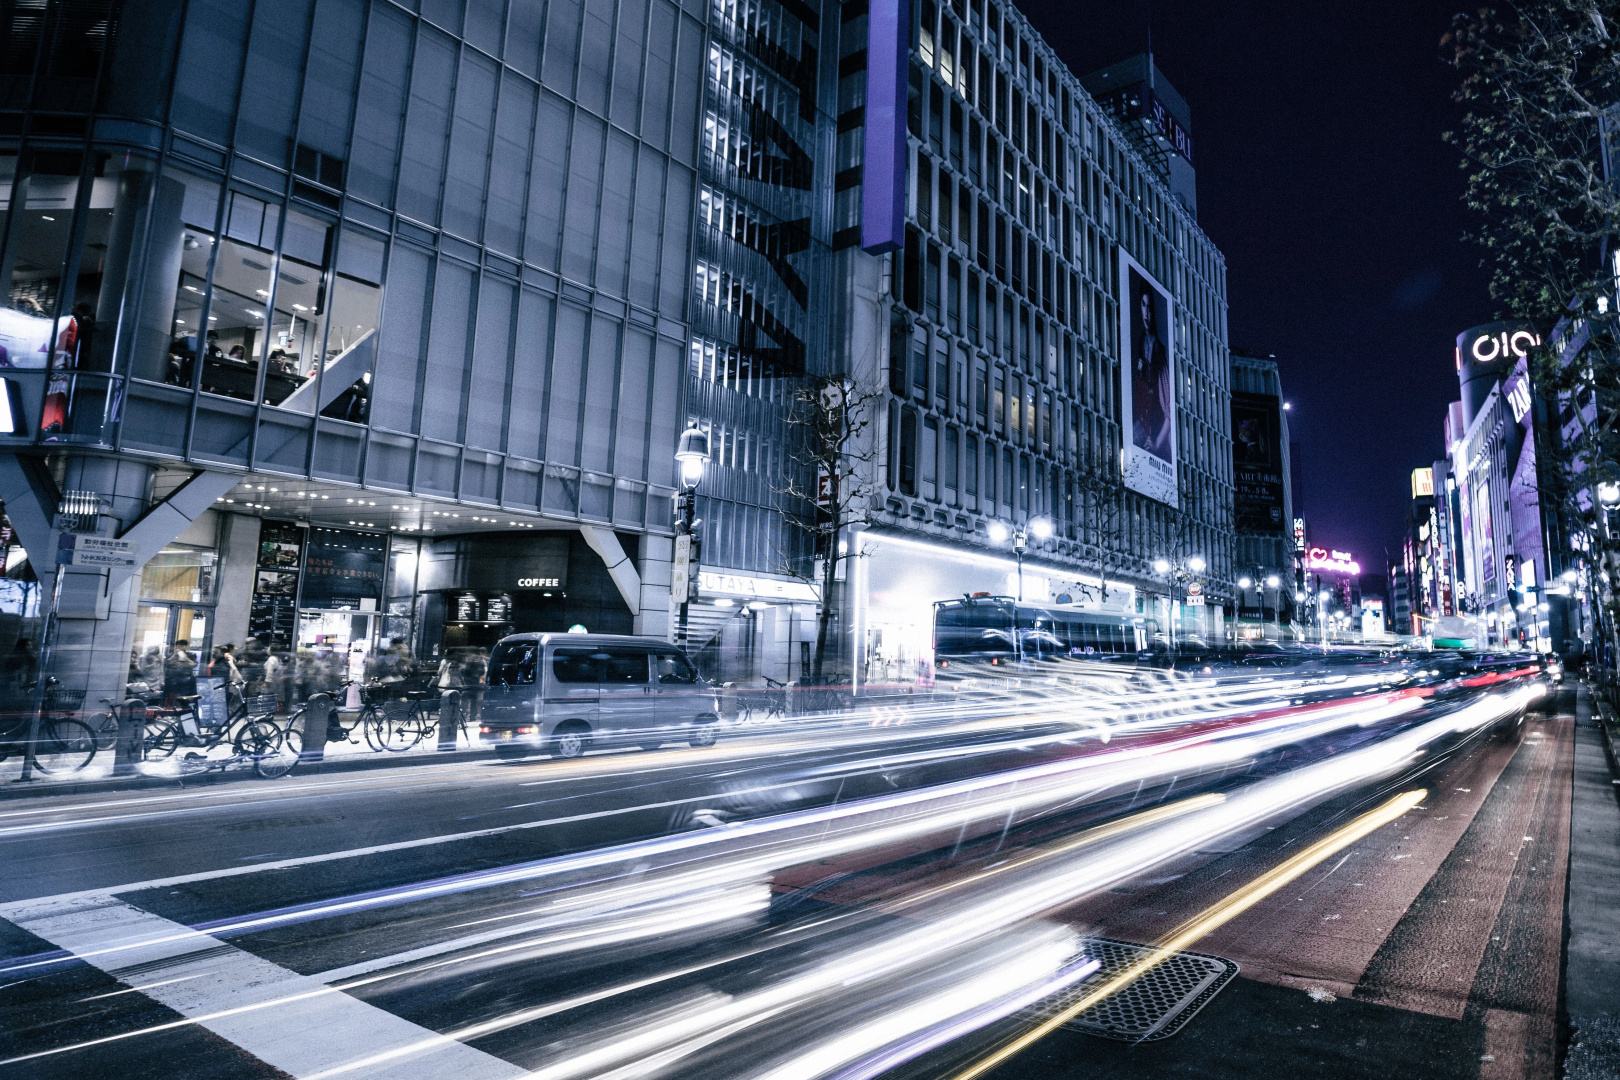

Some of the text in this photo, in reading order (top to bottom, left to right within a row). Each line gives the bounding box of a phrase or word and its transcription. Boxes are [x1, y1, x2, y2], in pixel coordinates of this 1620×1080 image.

[1153, 99, 1191, 161] SEIBU
[518, 578, 559, 587] COFFEE
[675, 540, 685, 597] 公園通り
[1506, 559, 1516, 591] ZARA
